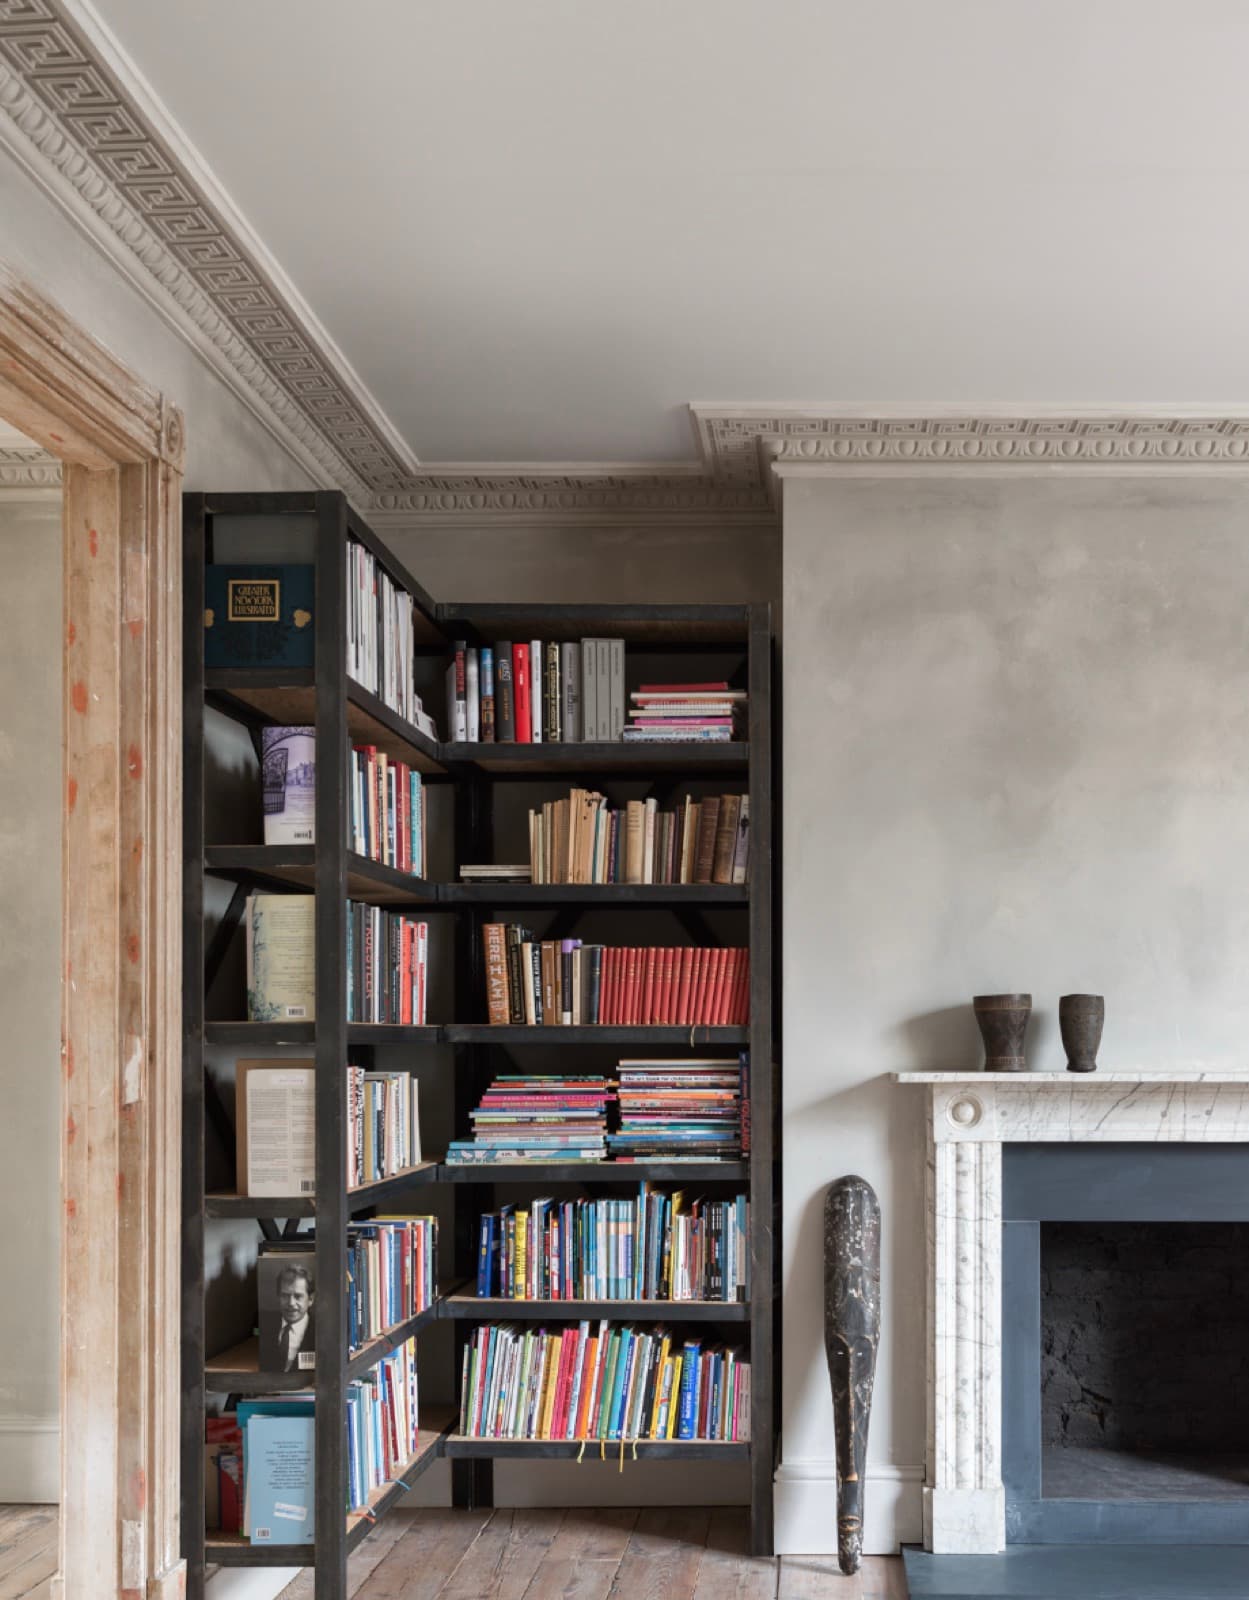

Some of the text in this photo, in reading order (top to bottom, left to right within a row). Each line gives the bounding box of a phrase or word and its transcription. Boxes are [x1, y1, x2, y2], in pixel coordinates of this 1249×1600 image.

[488, 927, 501, 963] HERE
[490, 965, 502, 975] I
[490, 978, 503, 999] AM
